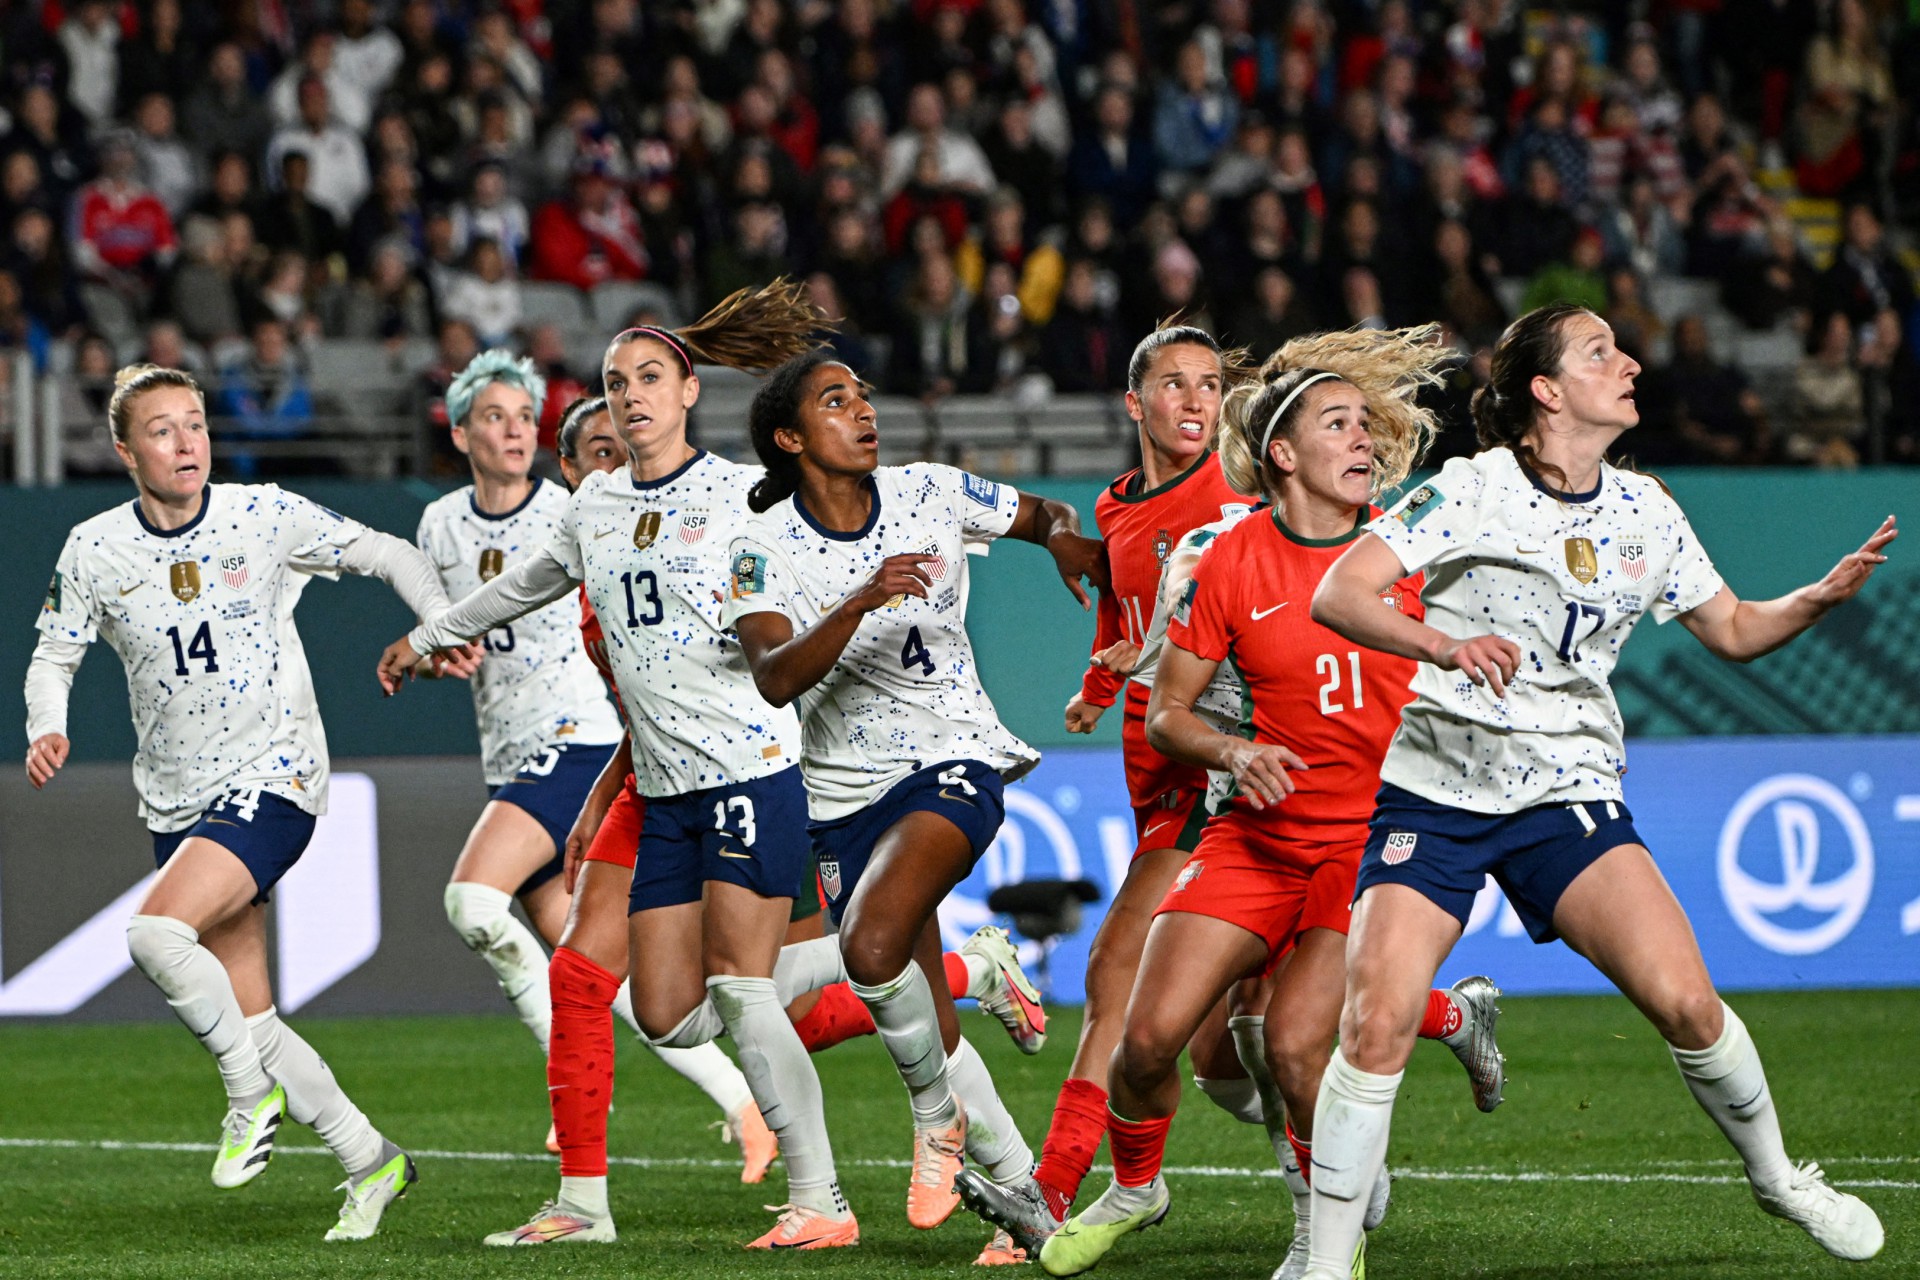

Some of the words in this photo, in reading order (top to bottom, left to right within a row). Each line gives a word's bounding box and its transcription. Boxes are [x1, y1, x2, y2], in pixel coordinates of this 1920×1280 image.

[683, 516, 707, 529] USA
[221, 555, 245, 571] USA
[1619, 545, 1643, 561] USA
[620, 570, 664, 628] 13
[166, 620, 219, 676] 14
[900, 624, 937, 677] 4
[1556, 601, 1606, 663] 17
[1316, 651, 1364, 715] 21
[713, 795, 757, 848] 13
[1389, 834, 1415, 848] USA
[821, 864, 837, 879] USA
